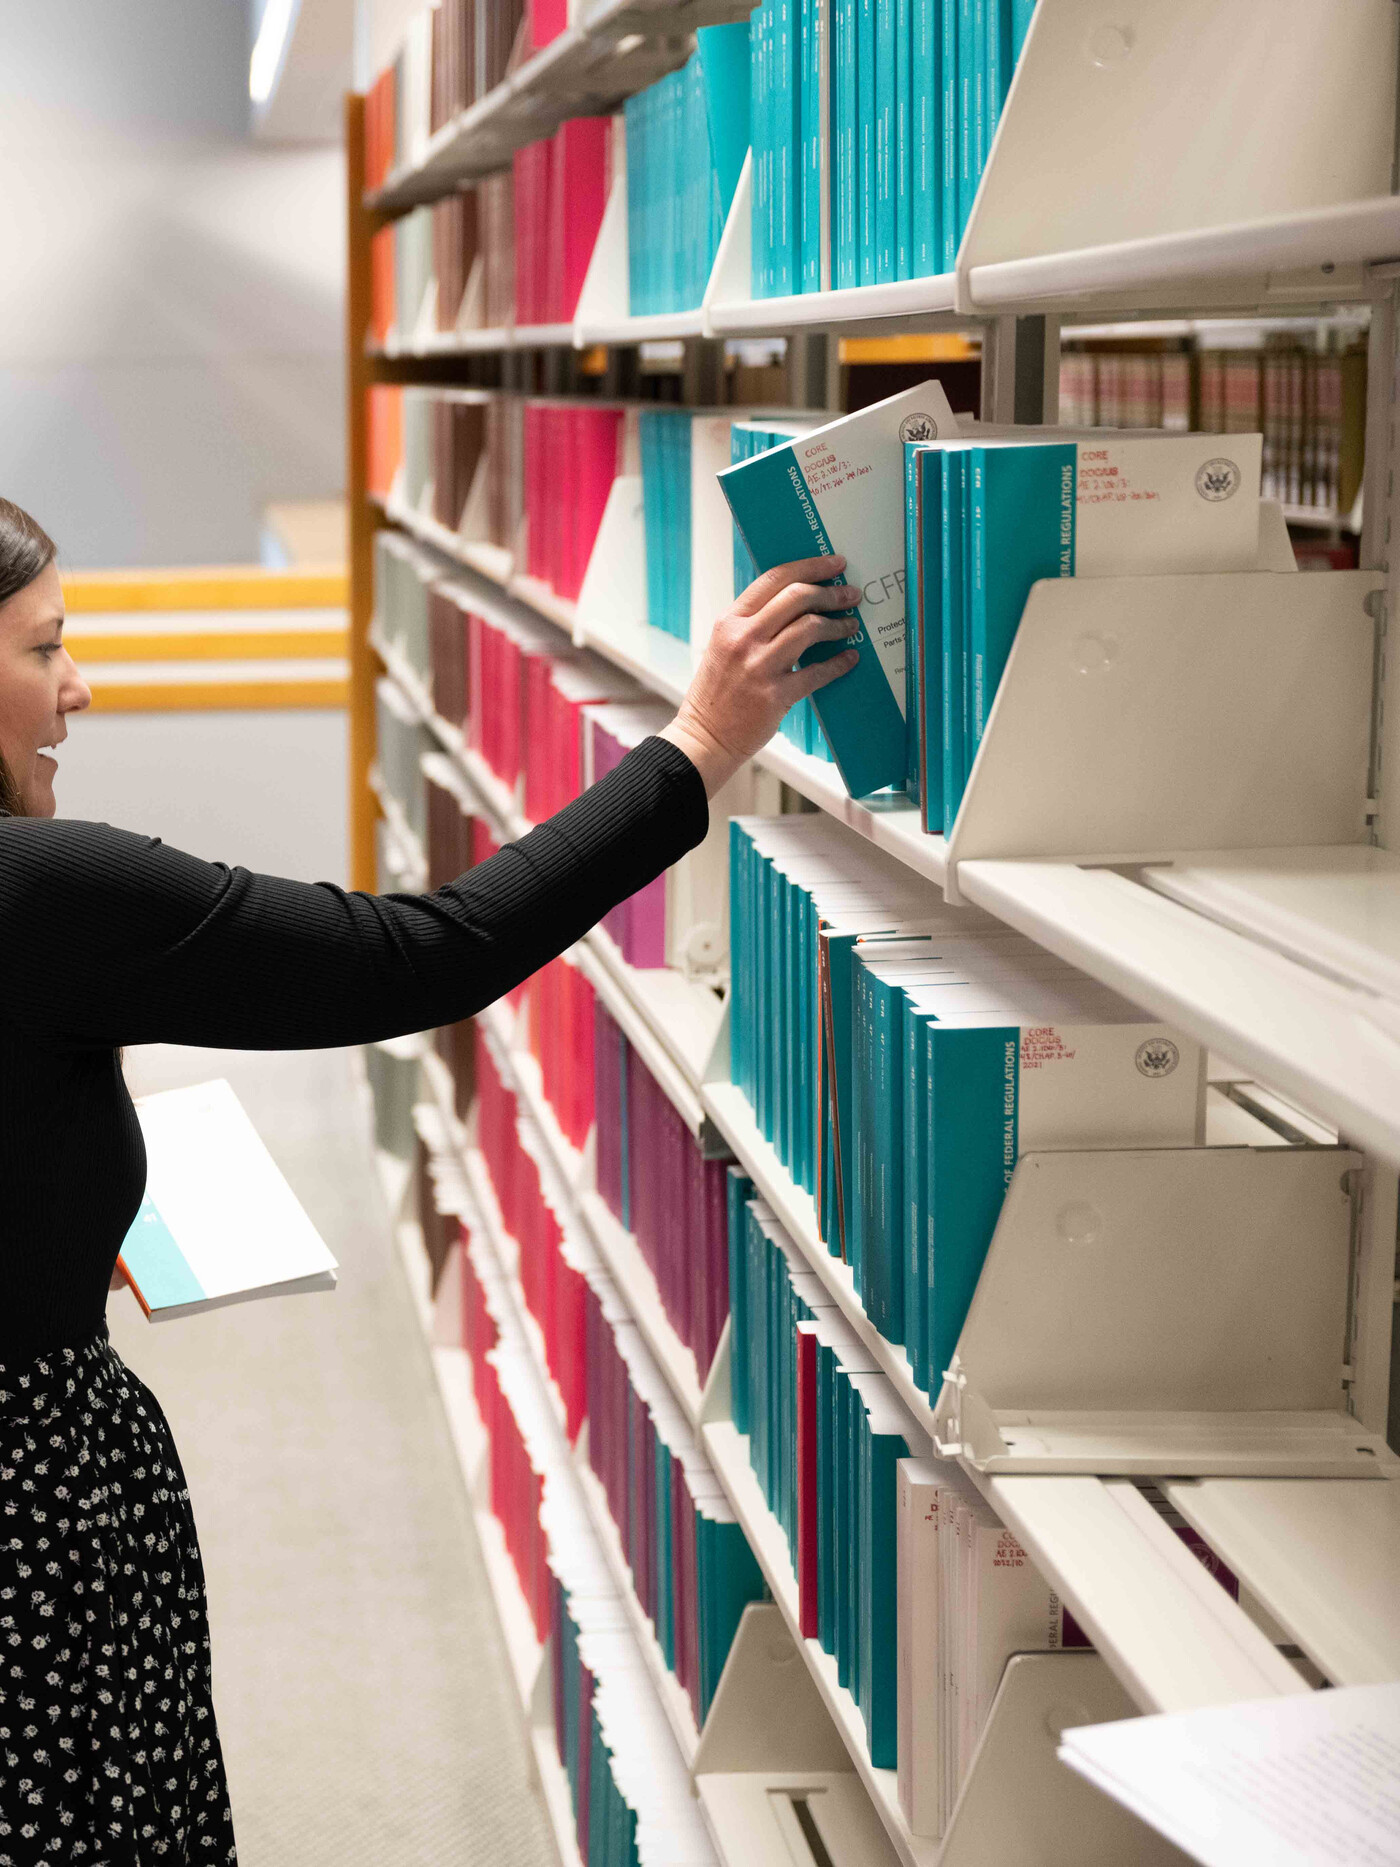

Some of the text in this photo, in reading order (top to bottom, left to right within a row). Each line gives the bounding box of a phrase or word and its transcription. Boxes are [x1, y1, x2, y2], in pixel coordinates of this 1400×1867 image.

[804, 442, 828, 458] CORE
[1081, 450, 1109, 461] CORE
[787, 465, 820, 532] REGULATIONS
[1060, 464, 1073, 577] ERAL REGULATIONS
[814, 531, 831, 557] ERAL
[846, 630, 865, 646] 40
[883, 637, 902, 649] Parts
[869, 1023, 874, 1036] 47
[1028, 1027, 1055, 1037] CORE
[880, 1032, 885, 1046] 47
[1004, 1041, 1016, 1183] OF FEDERAL REGULATIONS
